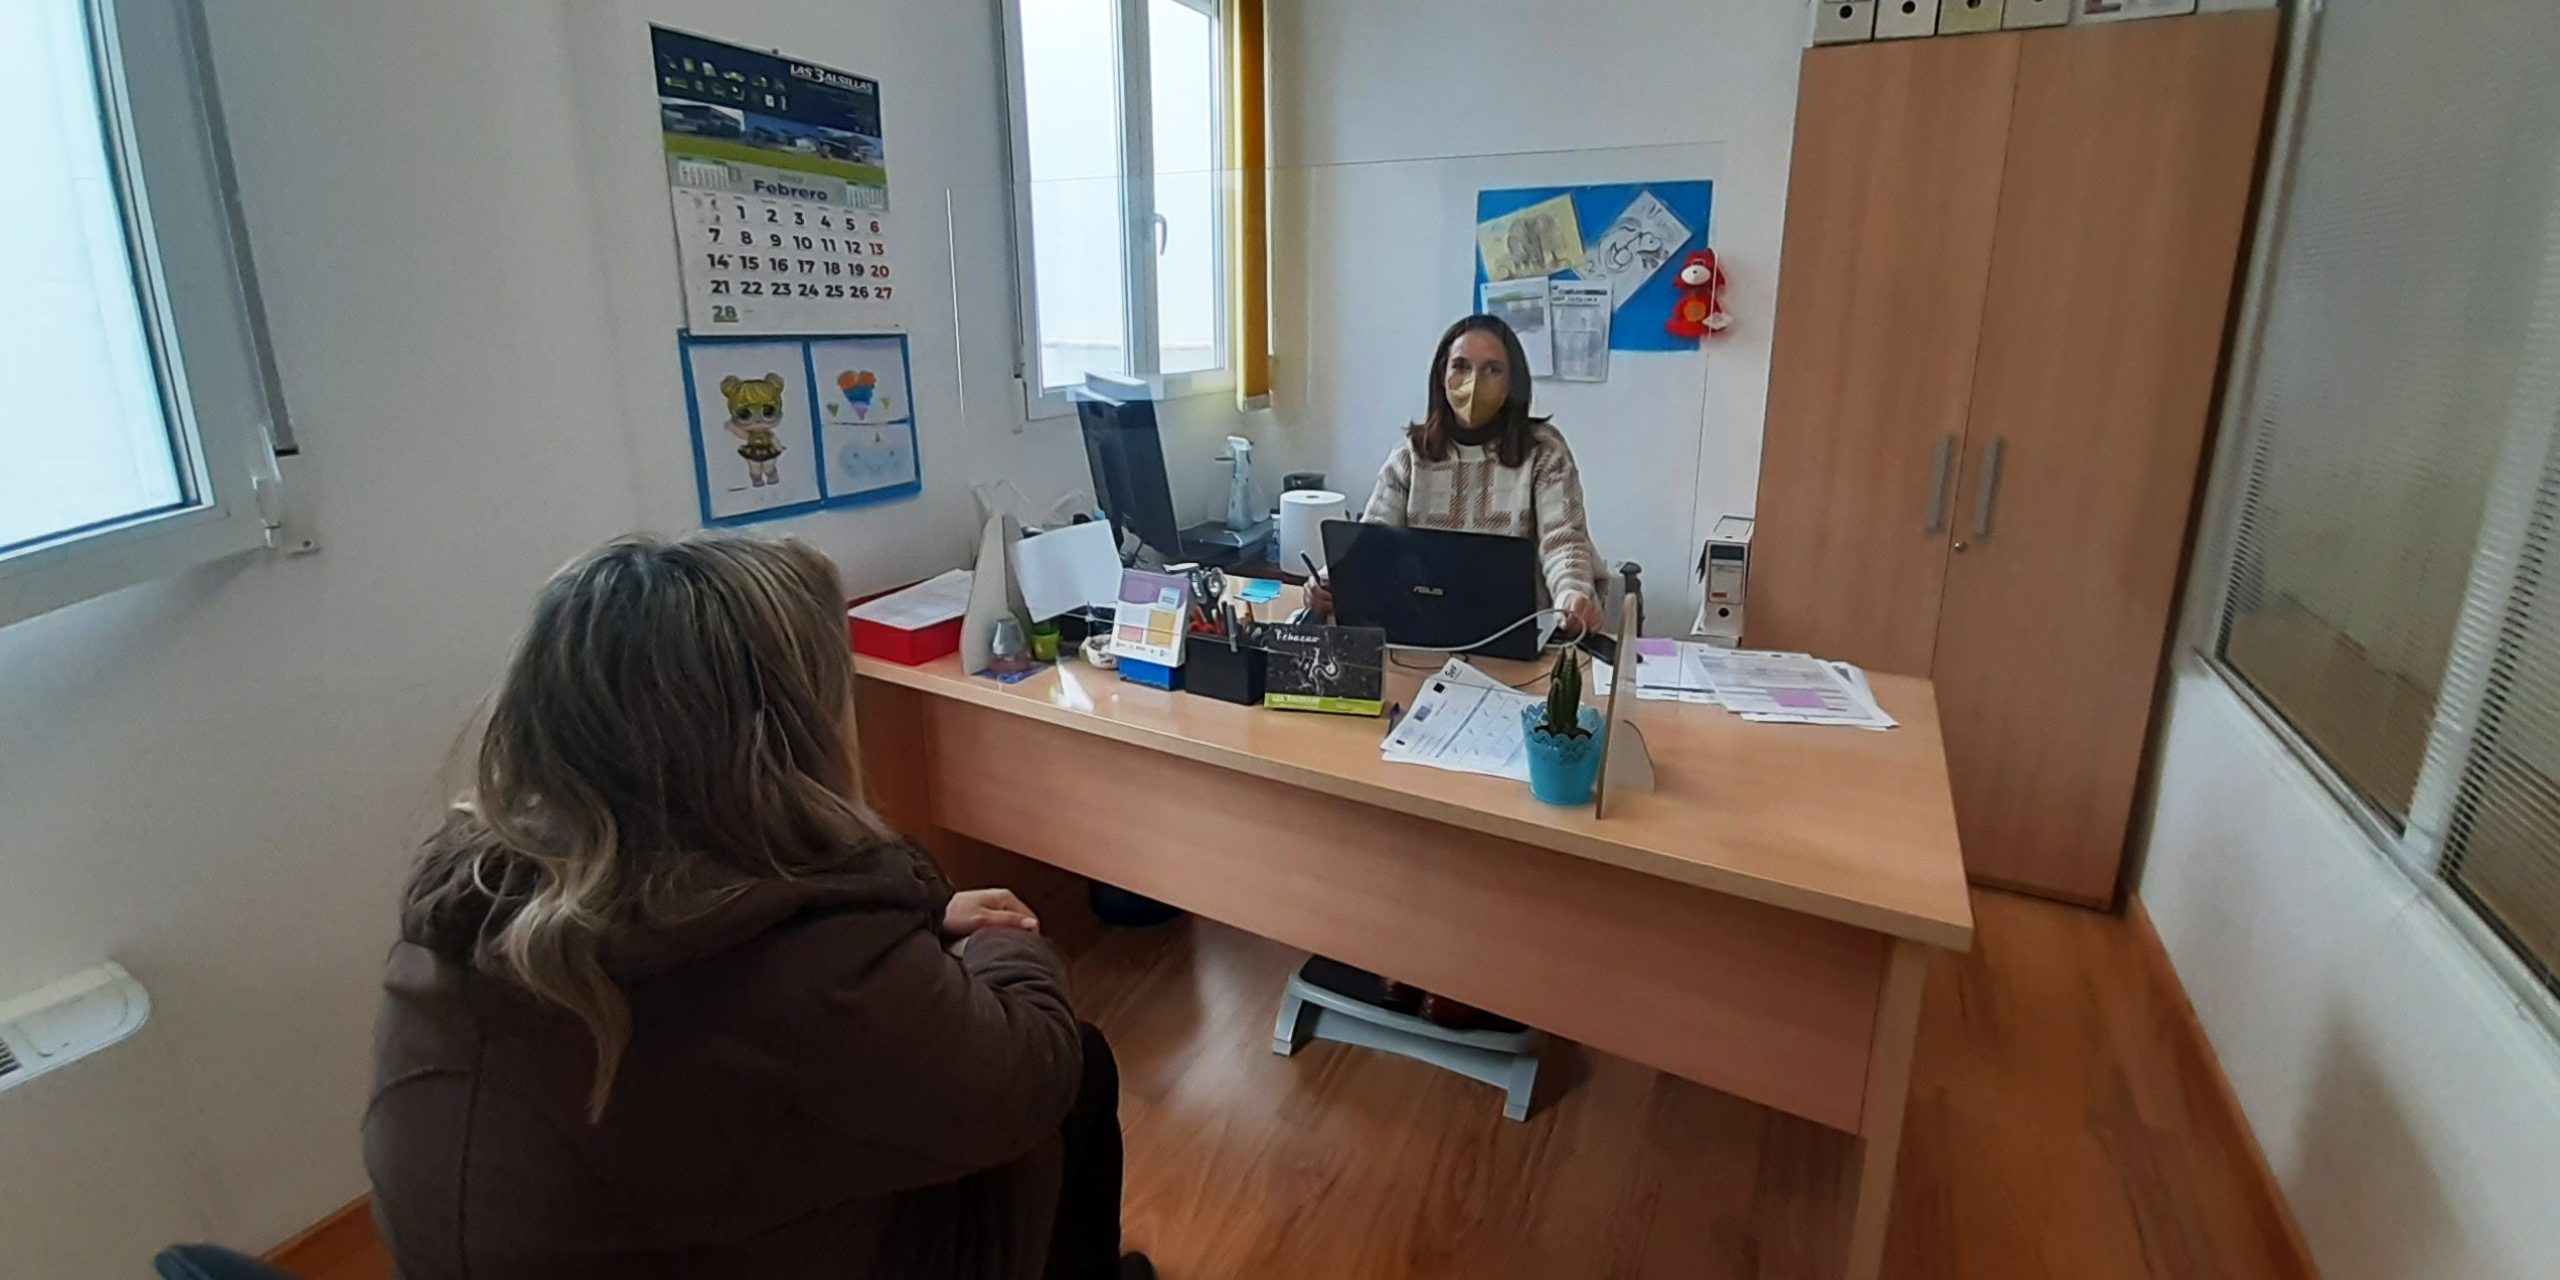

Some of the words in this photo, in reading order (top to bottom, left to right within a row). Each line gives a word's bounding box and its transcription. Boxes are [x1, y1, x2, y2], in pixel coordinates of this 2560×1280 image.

[790, 64, 813, 79] LAS
[753, 179, 828, 201] Febrero
[736, 204, 746, 220] 1
[765, 208, 779, 224] 2
[793, 211, 805, 226] 3
[819, 215, 832, 229] 4
[845, 217, 856, 231] 5
[869, 220, 881, 234] 6
[707, 227, 721, 243] 7
[740, 230, 754, 246] 8
[769, 233, 782, 248] 9
[792, 235, 813, 251] 10
[819, 237, 837, 253] 11
[844, 239, 862, 255] 12
[868, 242, 885, 256] 13
[706, 253, 730, 270] 14
[739, 255, 760, 271] 15
[768, 257, 789, 273] 16
[796, 259, 816, 274] 17
[823, 261, 841, 276] 18
[847, 262, 865, 278] 19
[870, 264, 890, 280] 20
[710, 279, 731, 295] 21
[739, 280, 764, 296] 22
[770, 282, 792, 297] 23
[797, 283, 820, 299] 24
[824, 284, 845, 299] 25
[849, 285, 870, 300] 26
[873, 286, 893, 300] 27
[712, 304, 739, 320] 28
[1413, 585, 1444, 596] ASUS
